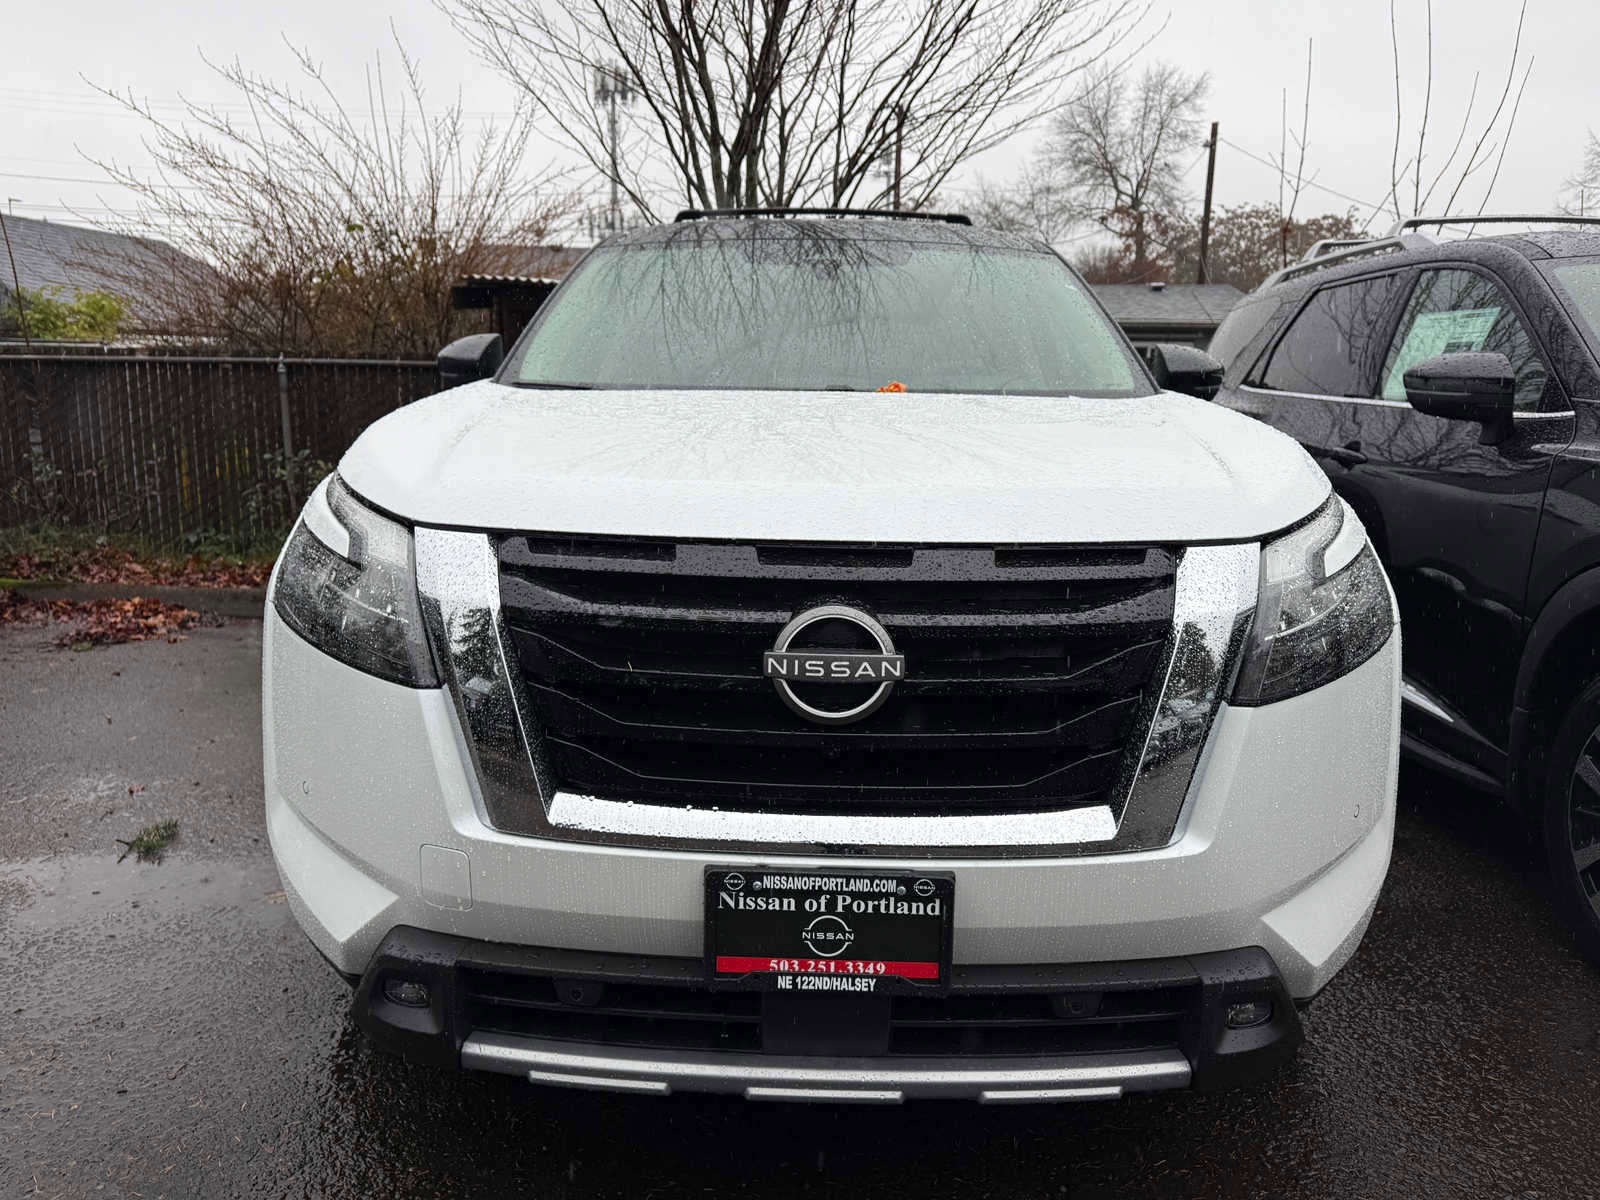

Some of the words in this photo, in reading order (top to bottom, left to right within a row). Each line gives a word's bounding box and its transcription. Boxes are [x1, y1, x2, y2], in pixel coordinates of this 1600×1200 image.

[768, 658, 900, 677] NISSAN
[763, 875, 897, 893] NISSANOFPORTLAND.COM
[717, 891, 796, 911] Nissan
[805, 894, 830, 912] of
[836, 896, 940, 916] Portland
[802, 931, 854, 941] NISSAN
[769, 960, 886, 975] 503.251.3349
[777, 976, 793, 990] NE
[796, 976, 876, 992] 122ND/HALSEY
